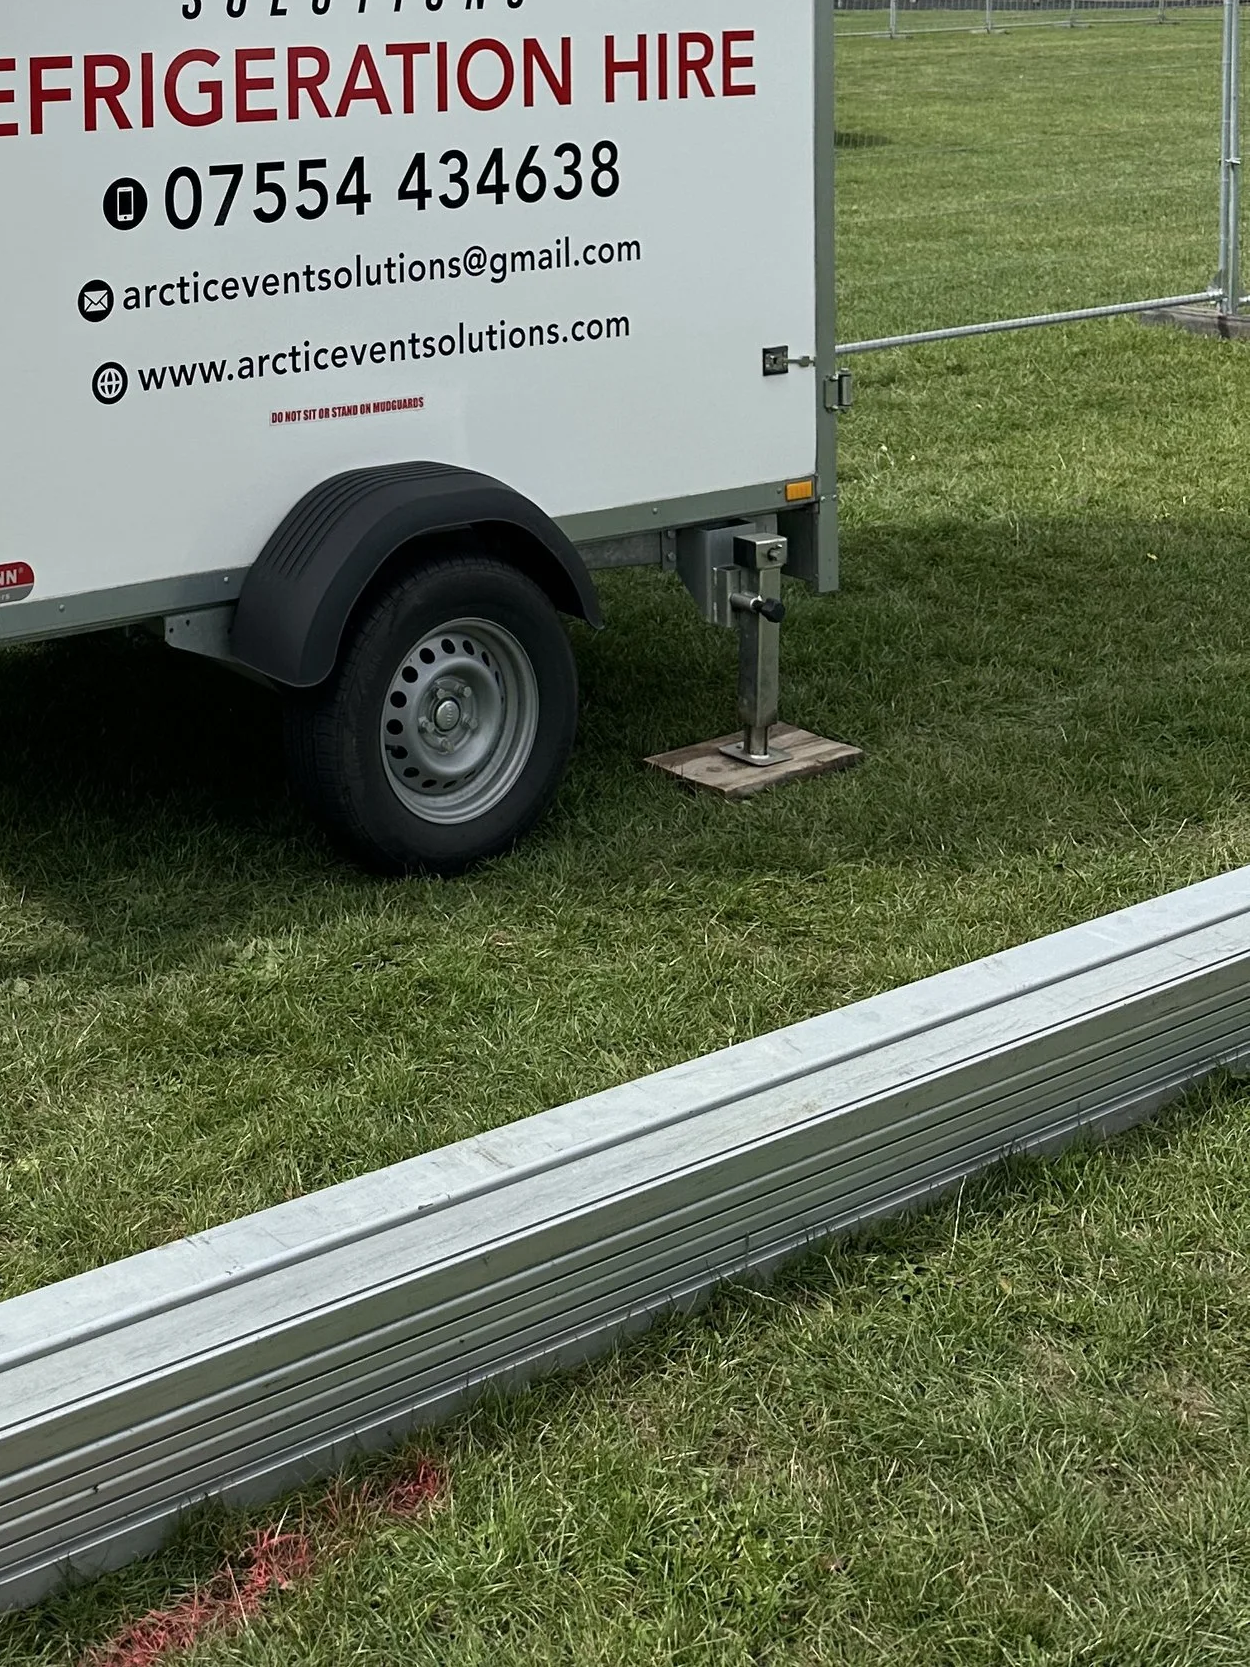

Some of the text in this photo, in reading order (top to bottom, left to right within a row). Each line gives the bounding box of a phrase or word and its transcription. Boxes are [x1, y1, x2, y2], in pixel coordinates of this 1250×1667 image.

[604, 30, 756, 103] HIRE
[163, 139, 621, 230] 07554 434638
[121, 236, 642, 311] arcticeventsolutions@gmail.com
[137, 315, 631, 392] www.arcticeventsolutions.com
[271, 396, 424, 424] DO NOT SIT OR STAND ON MUDGUARDS
